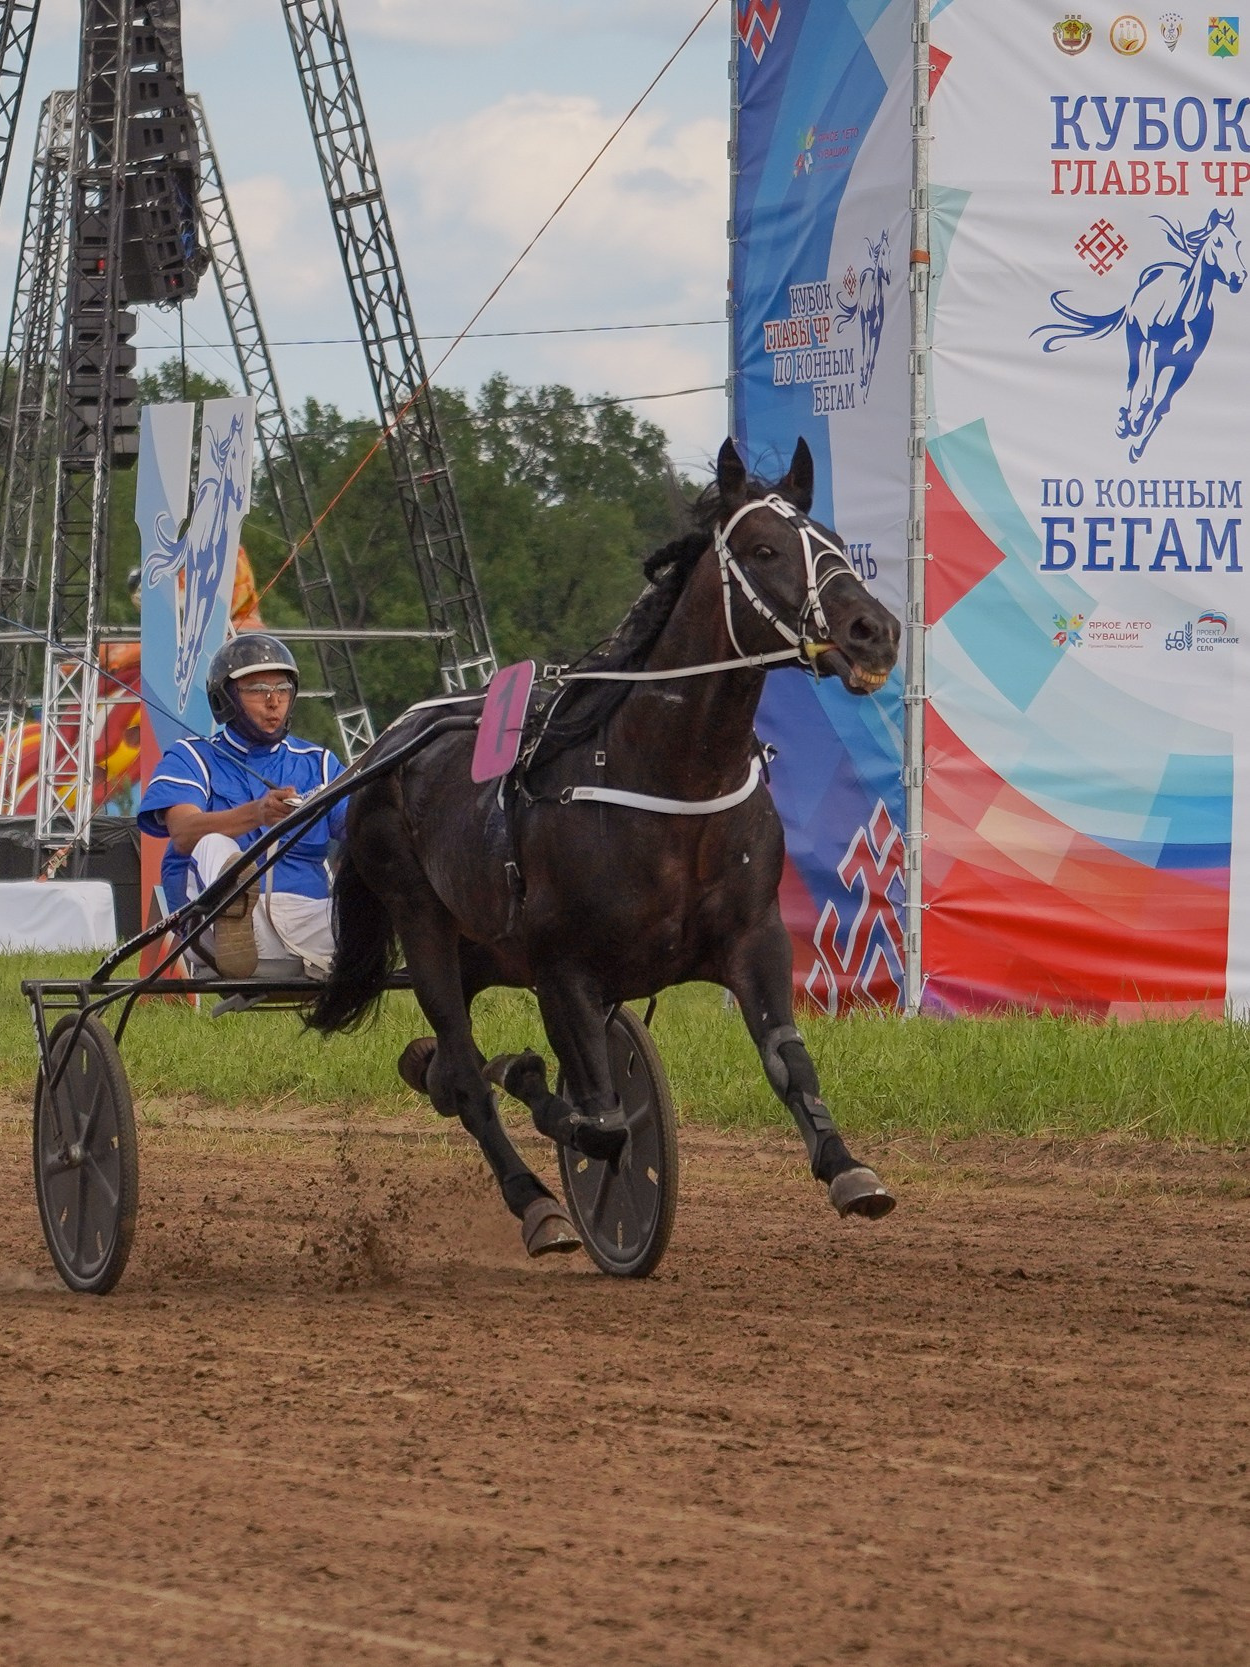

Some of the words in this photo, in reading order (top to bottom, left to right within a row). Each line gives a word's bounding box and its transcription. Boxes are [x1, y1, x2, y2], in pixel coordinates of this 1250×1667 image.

[1050, 95, 1250, 152] КУБОК
[1051, 160, 1189, 195] ГЛАВЫ
[1201, 161, 1250, 196] ЧР
[790, 283, 833, 314] КУБОК
[764, 318, 812, 350] ГЛАВЫ
[812, 316, 830, 343] ЧР
[773, 355, 793, 383] ПО
[796, 348, 855, 380] КОННЫМ
[814, 383, 855, 413] БЕГАМ
[1041, 478, 1085, 508] ПО
[1094, 479, 1243, 509] КОННЫМ
[1040, 516, 1243, 573] БЕГАМ
[1088, 621, 1121, 630] ЯРКОЕ
[1125, 621, 1152, 630] ЛЕТО
[1088, 633, 1139, 641] ЧУВАШИИ
[1196, 636, 1239, 644] РОССИЙСКОЕ
[496, 669, 519, 754] 1
